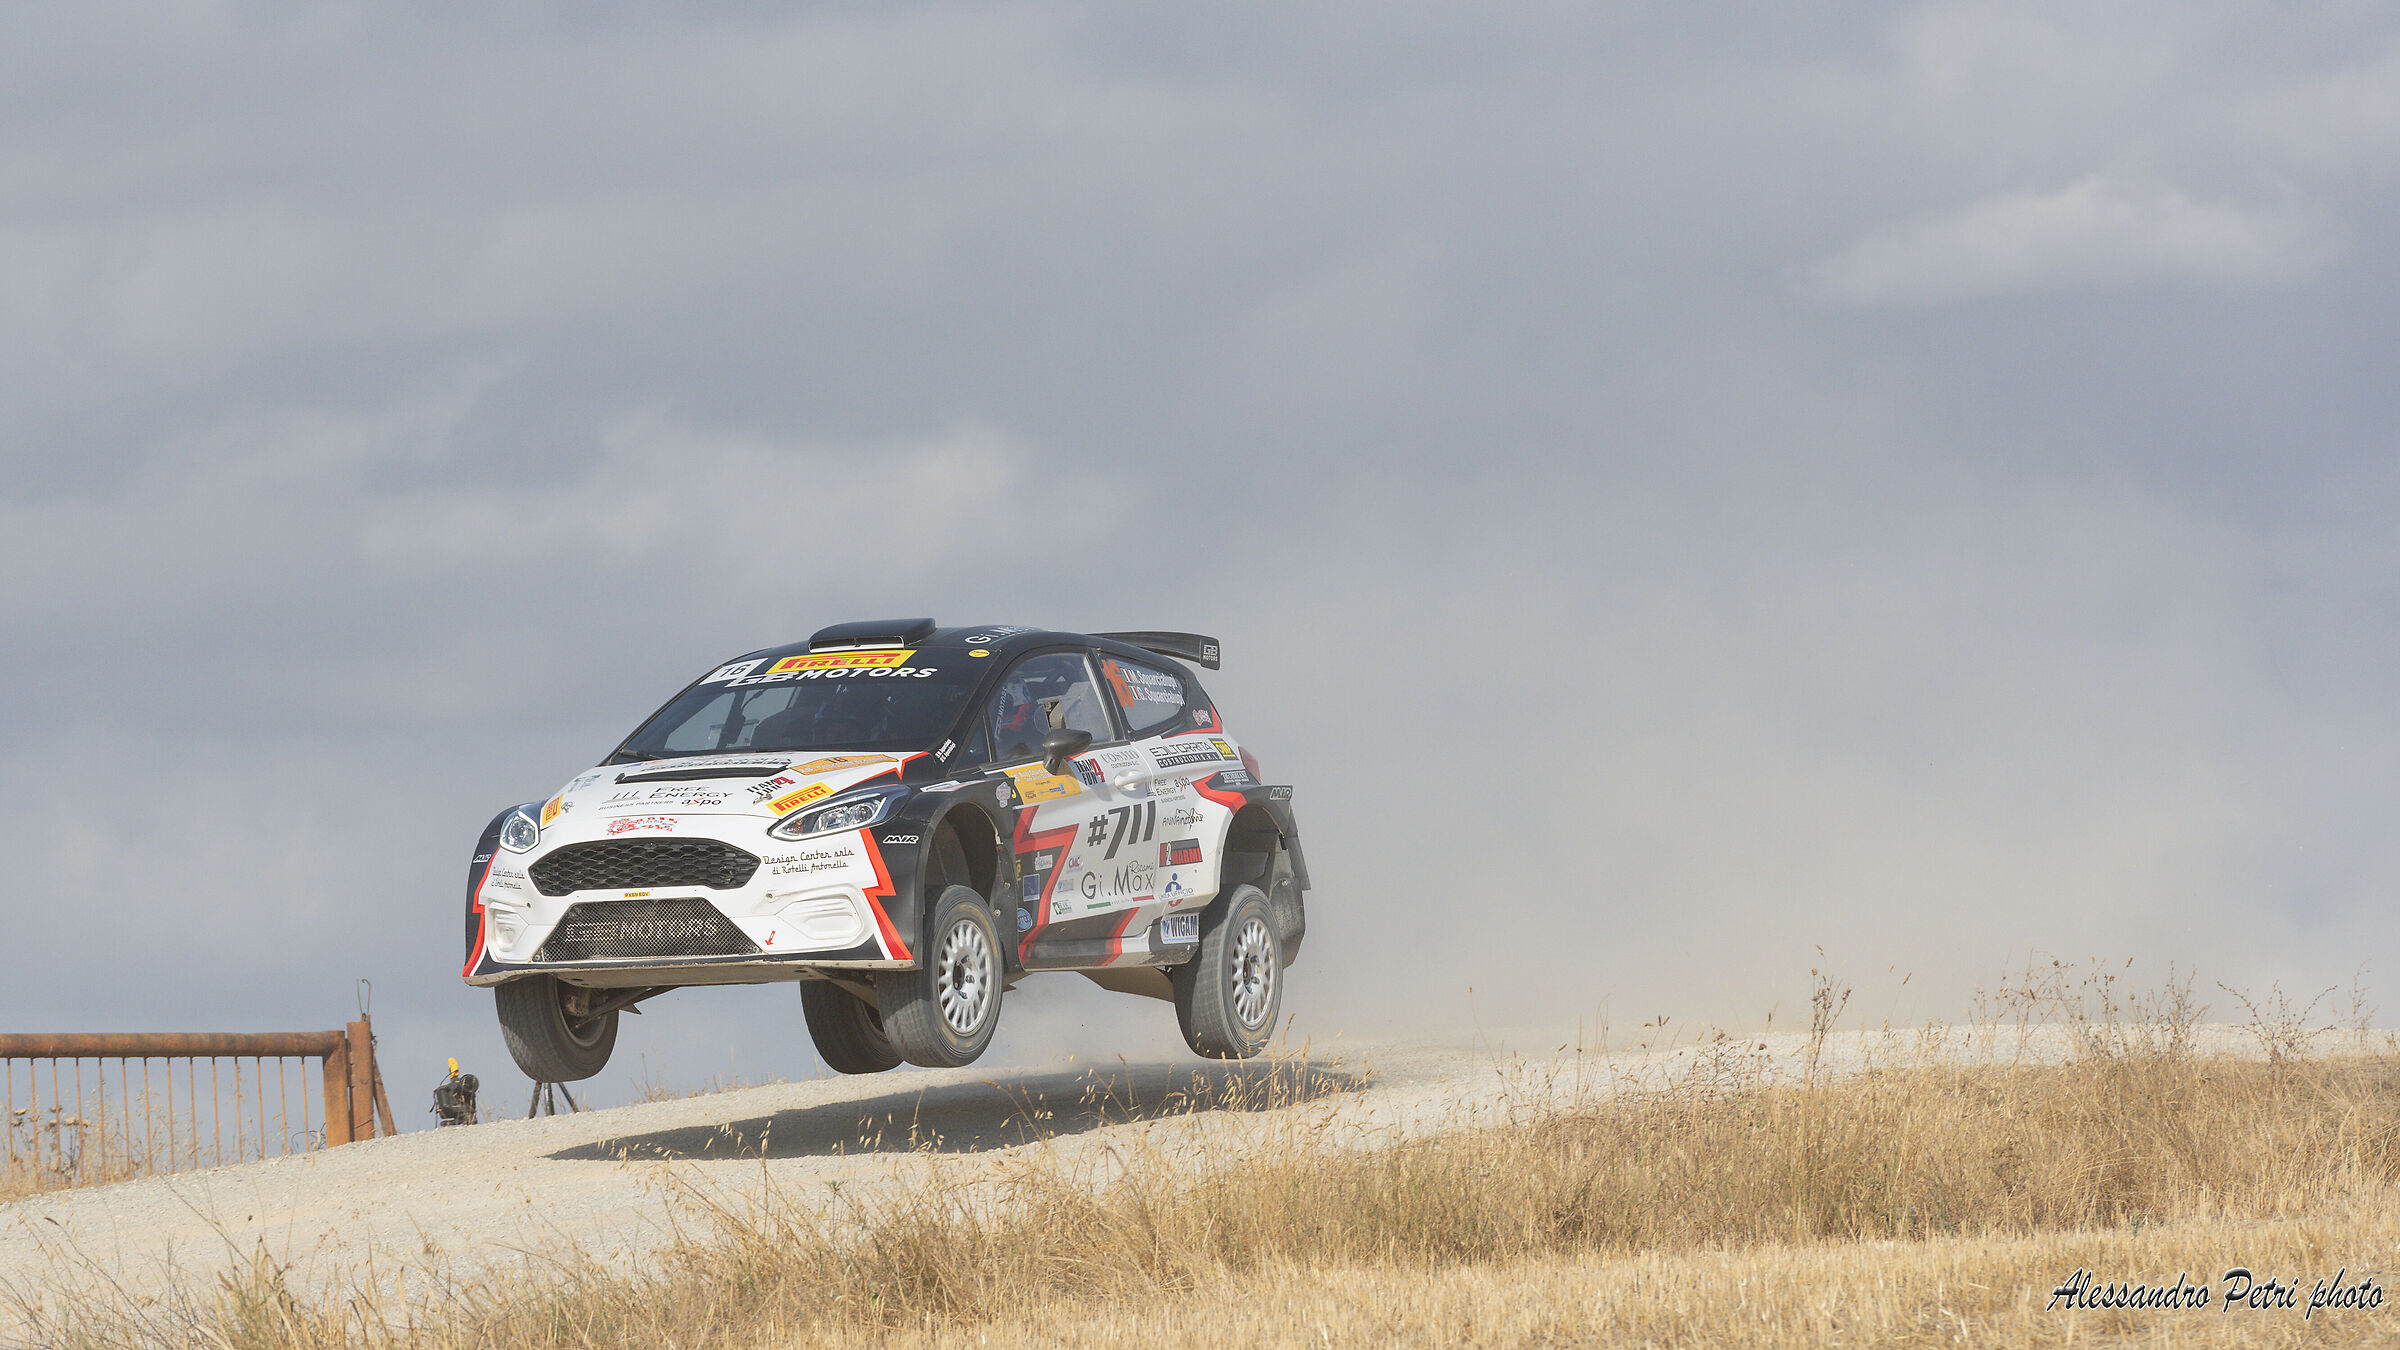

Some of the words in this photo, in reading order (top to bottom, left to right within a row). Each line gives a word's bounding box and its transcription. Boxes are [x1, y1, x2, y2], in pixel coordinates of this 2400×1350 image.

[779, 653, 901, 669] PIRELLI
[720, 664, 748, 678] 16
[796, 667, 937, 681] MOTORS
[1159, 753, 1202, 767] COSTRUZIONI
[1074, 759, 1092, 773] TEAM
[1090, 758, 1105, 783] 4
[1082, 771, 1098, 786] FUN
[745, 779, 776, 793] TEAM
[774, 776, 796, 785] 4
[774, 785, 826, 811] PIRELLI
[1087, 800, 1156, 860] #711
[762, 854, 798, 866] Design
[800, 850, 832, 860] Center
[834, 847, 855, 857] srls
[1171, 848, 1202, 865] MARMI
[772, 866, 781, 874] di
[782, 864, 809, 873] Rotelli
[811, 860, 849, 873] Antonella
[1170, 915, 1198, 937] WIGAM
